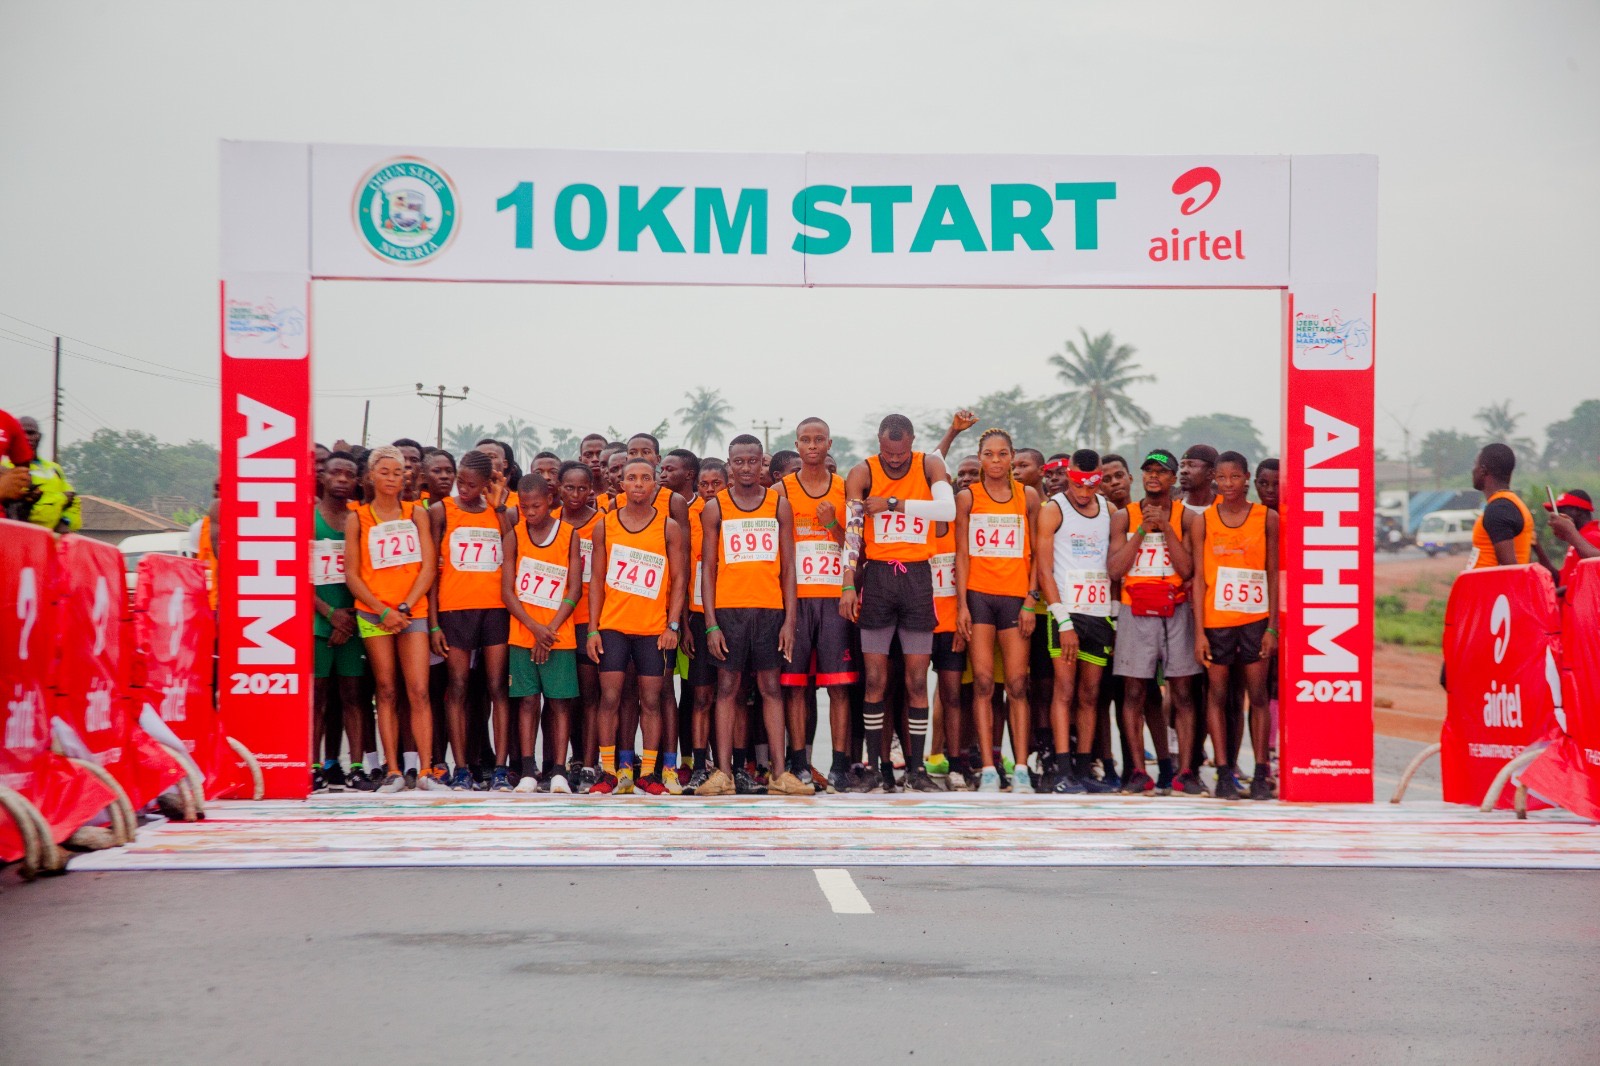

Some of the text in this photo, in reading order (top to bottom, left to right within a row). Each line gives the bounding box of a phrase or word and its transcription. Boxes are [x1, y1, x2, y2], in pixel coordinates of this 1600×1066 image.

[496, 182, 1117, 255] 10KM START
[379, 241, 440, 260] NIGERIA
[1148, 228, 1246, 262] airtel
[237, 394, 296, 665] AIHHM
[881, 514, 924, 534] 755
[377, 535, 415, 558] 720
[730, 533, 773, 552] 696
[976, 528, 1015, 548] 644
[1303, 405, 1360, 673] AIHHM
[458, 542, 497, 562] 771
[642, 553, 664, 566] HERITAGE
[616, 560, 656, 588] 740
[802, 556, 841, 576] 625
[520, 573, 561, 599] 677
[1073, 584, 1106, 604] 786
[1223, 583, 1263, 604] 653
[230, 673, 299, 694] 2021
[1296, 680, 1362, 702] 2021
[1484, 680, 1523, 728] airtel
